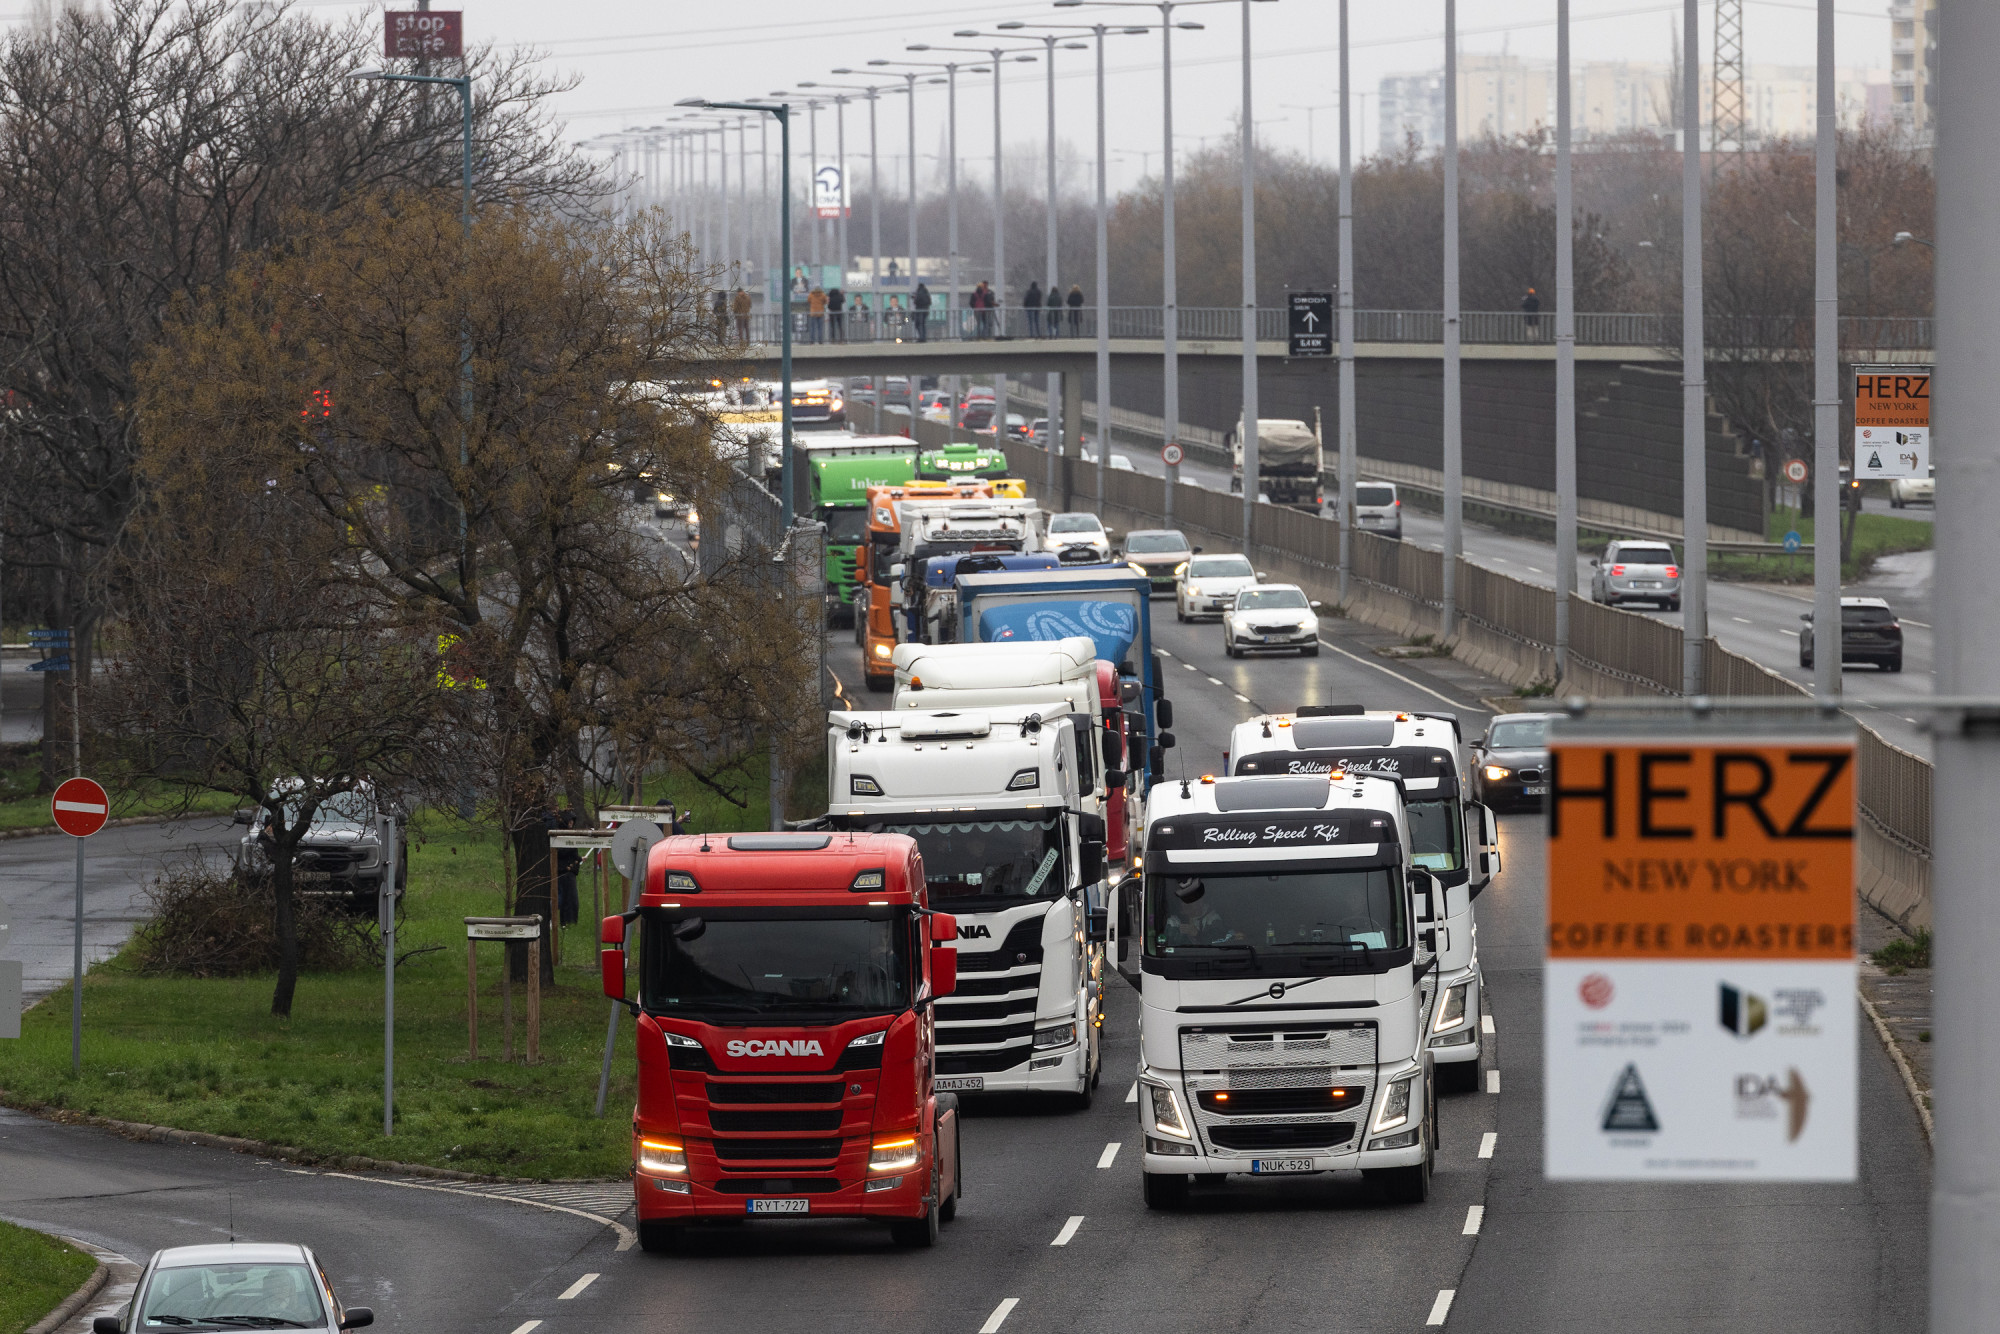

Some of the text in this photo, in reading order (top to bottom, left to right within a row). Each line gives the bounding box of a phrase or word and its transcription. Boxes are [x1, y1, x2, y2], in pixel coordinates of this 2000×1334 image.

[1856, 377, 1929, 398] HERZ
[1288, 757, 1399, 774] Rolling Speed Kft
[1549, 752, 1854, 839] HERZ
[1203, 823, 1340, 844] Rolling Speed Kft
[1603, 857, 1810, 893] NEW YORK
[956, 924, 992, 939] NIA
[1549, 922, 1853, 950] COFFEE ROASTERS
[726, 1039, 825, 1057] SCANIA
[1261, 1160, 1311, 1171] NUK-529
[755, 1200, 806, 1211] RYT-727
